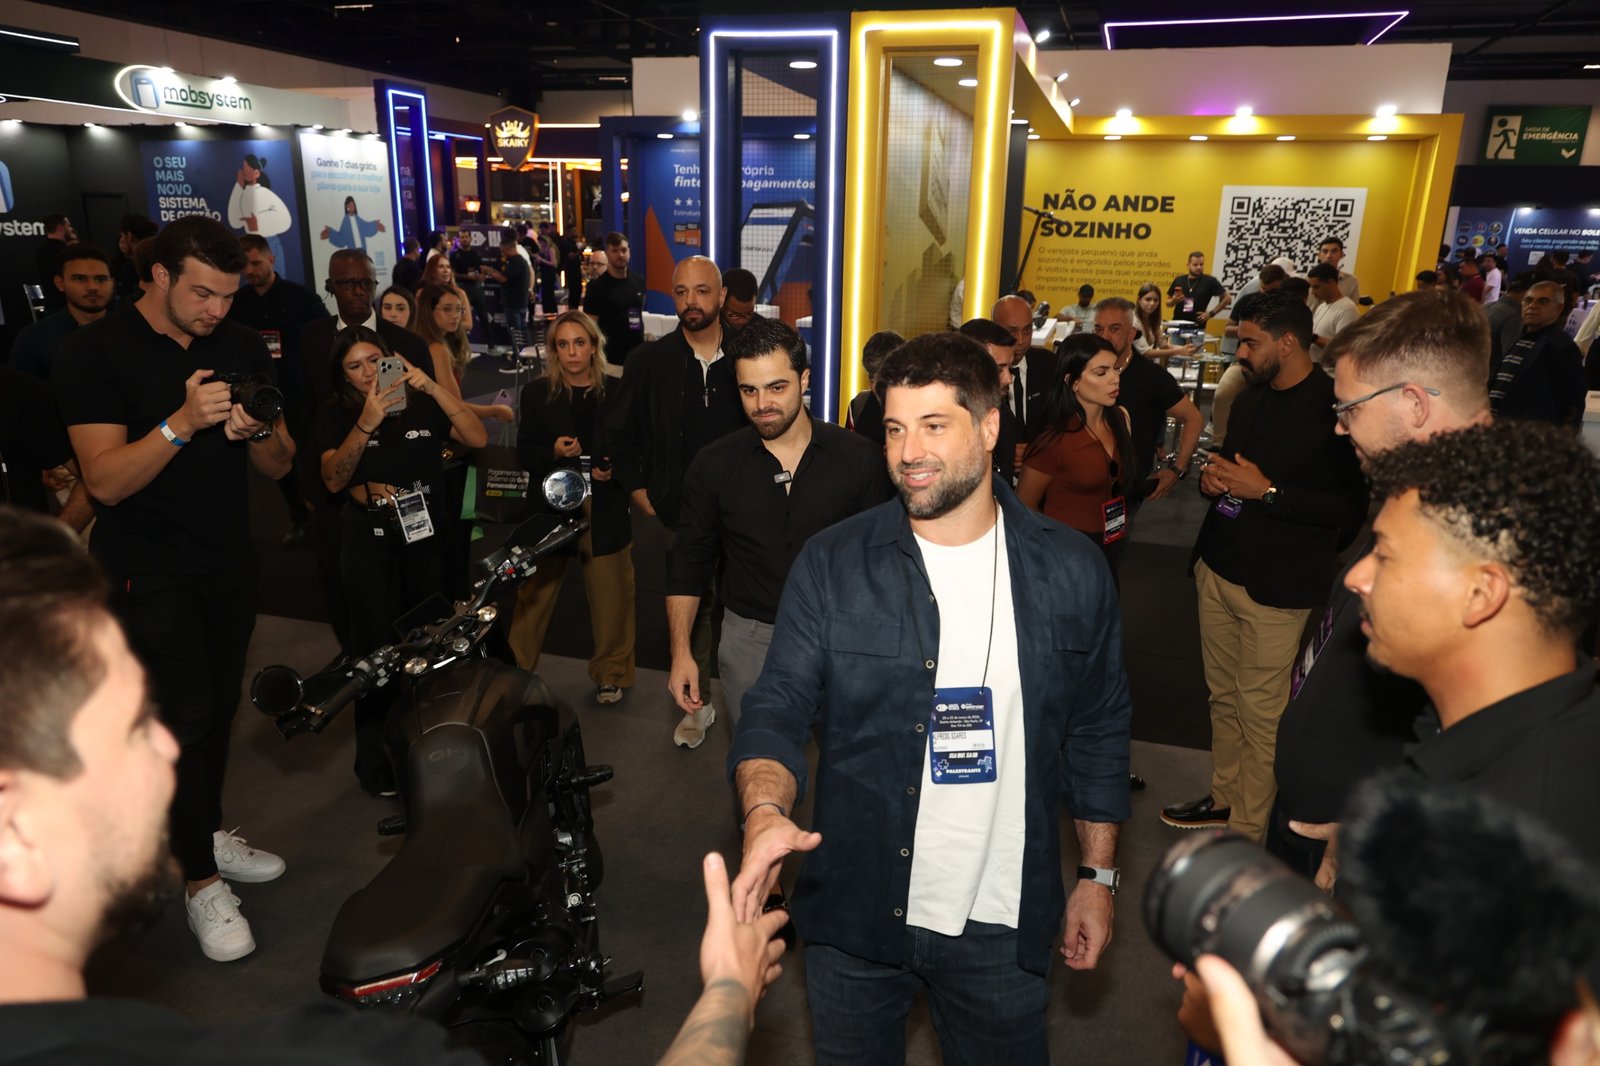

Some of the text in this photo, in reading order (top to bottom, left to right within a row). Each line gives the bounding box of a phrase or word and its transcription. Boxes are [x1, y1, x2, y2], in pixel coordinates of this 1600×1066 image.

[164, 85, 252, 109] mobsystem
[1522, 131, 1579, 140] EMERGÊNCIA
[498, 138, 529, 147] SKAIKY
[153, 157, 187, 168] O SEU
[316, 157, 339, 168] Ganhe
[345, 160, 358, 169] dias
[155, 171, 185, 181] MAIS
[742, 165, 775, 178] ópria
[157, 183, 192, 195] NOVO
[159, 197, 208, 209] SISTEMA
[1042, 188, 1176, 213] NÃO ANDE
[161, 210, 176, 222] DE
[1040, 220, 1152, 240] SOZINHO
[1038, 246, 1158, 258] O varejista pequeno que anda
[1076, 257, 1113, 266] engolido
[1113, 258, 1135, 267] pelos
[1036, 275, 1069, 283] importe
[1132, 269, 1152, 277] você
[1047, 285, 1080, 293] centena
